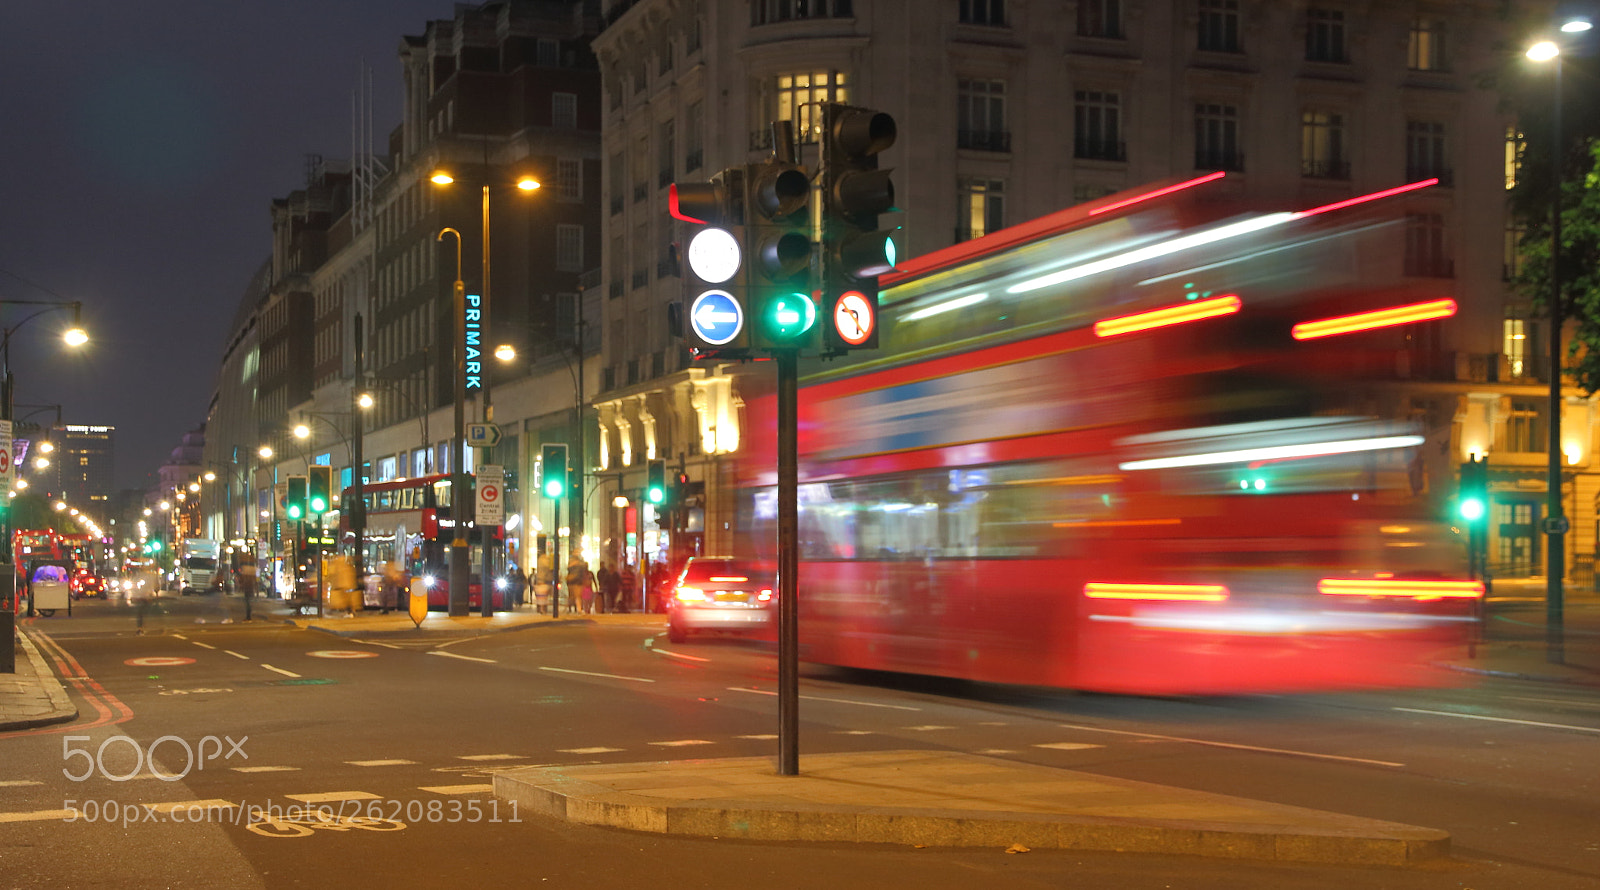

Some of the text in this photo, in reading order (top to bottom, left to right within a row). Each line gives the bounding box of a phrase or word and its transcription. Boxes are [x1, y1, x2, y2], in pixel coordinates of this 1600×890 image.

[466, 294, 481, 388] PRIMARK
[474, 428, 483, 439] P
[482, 486, 496, 501] C
